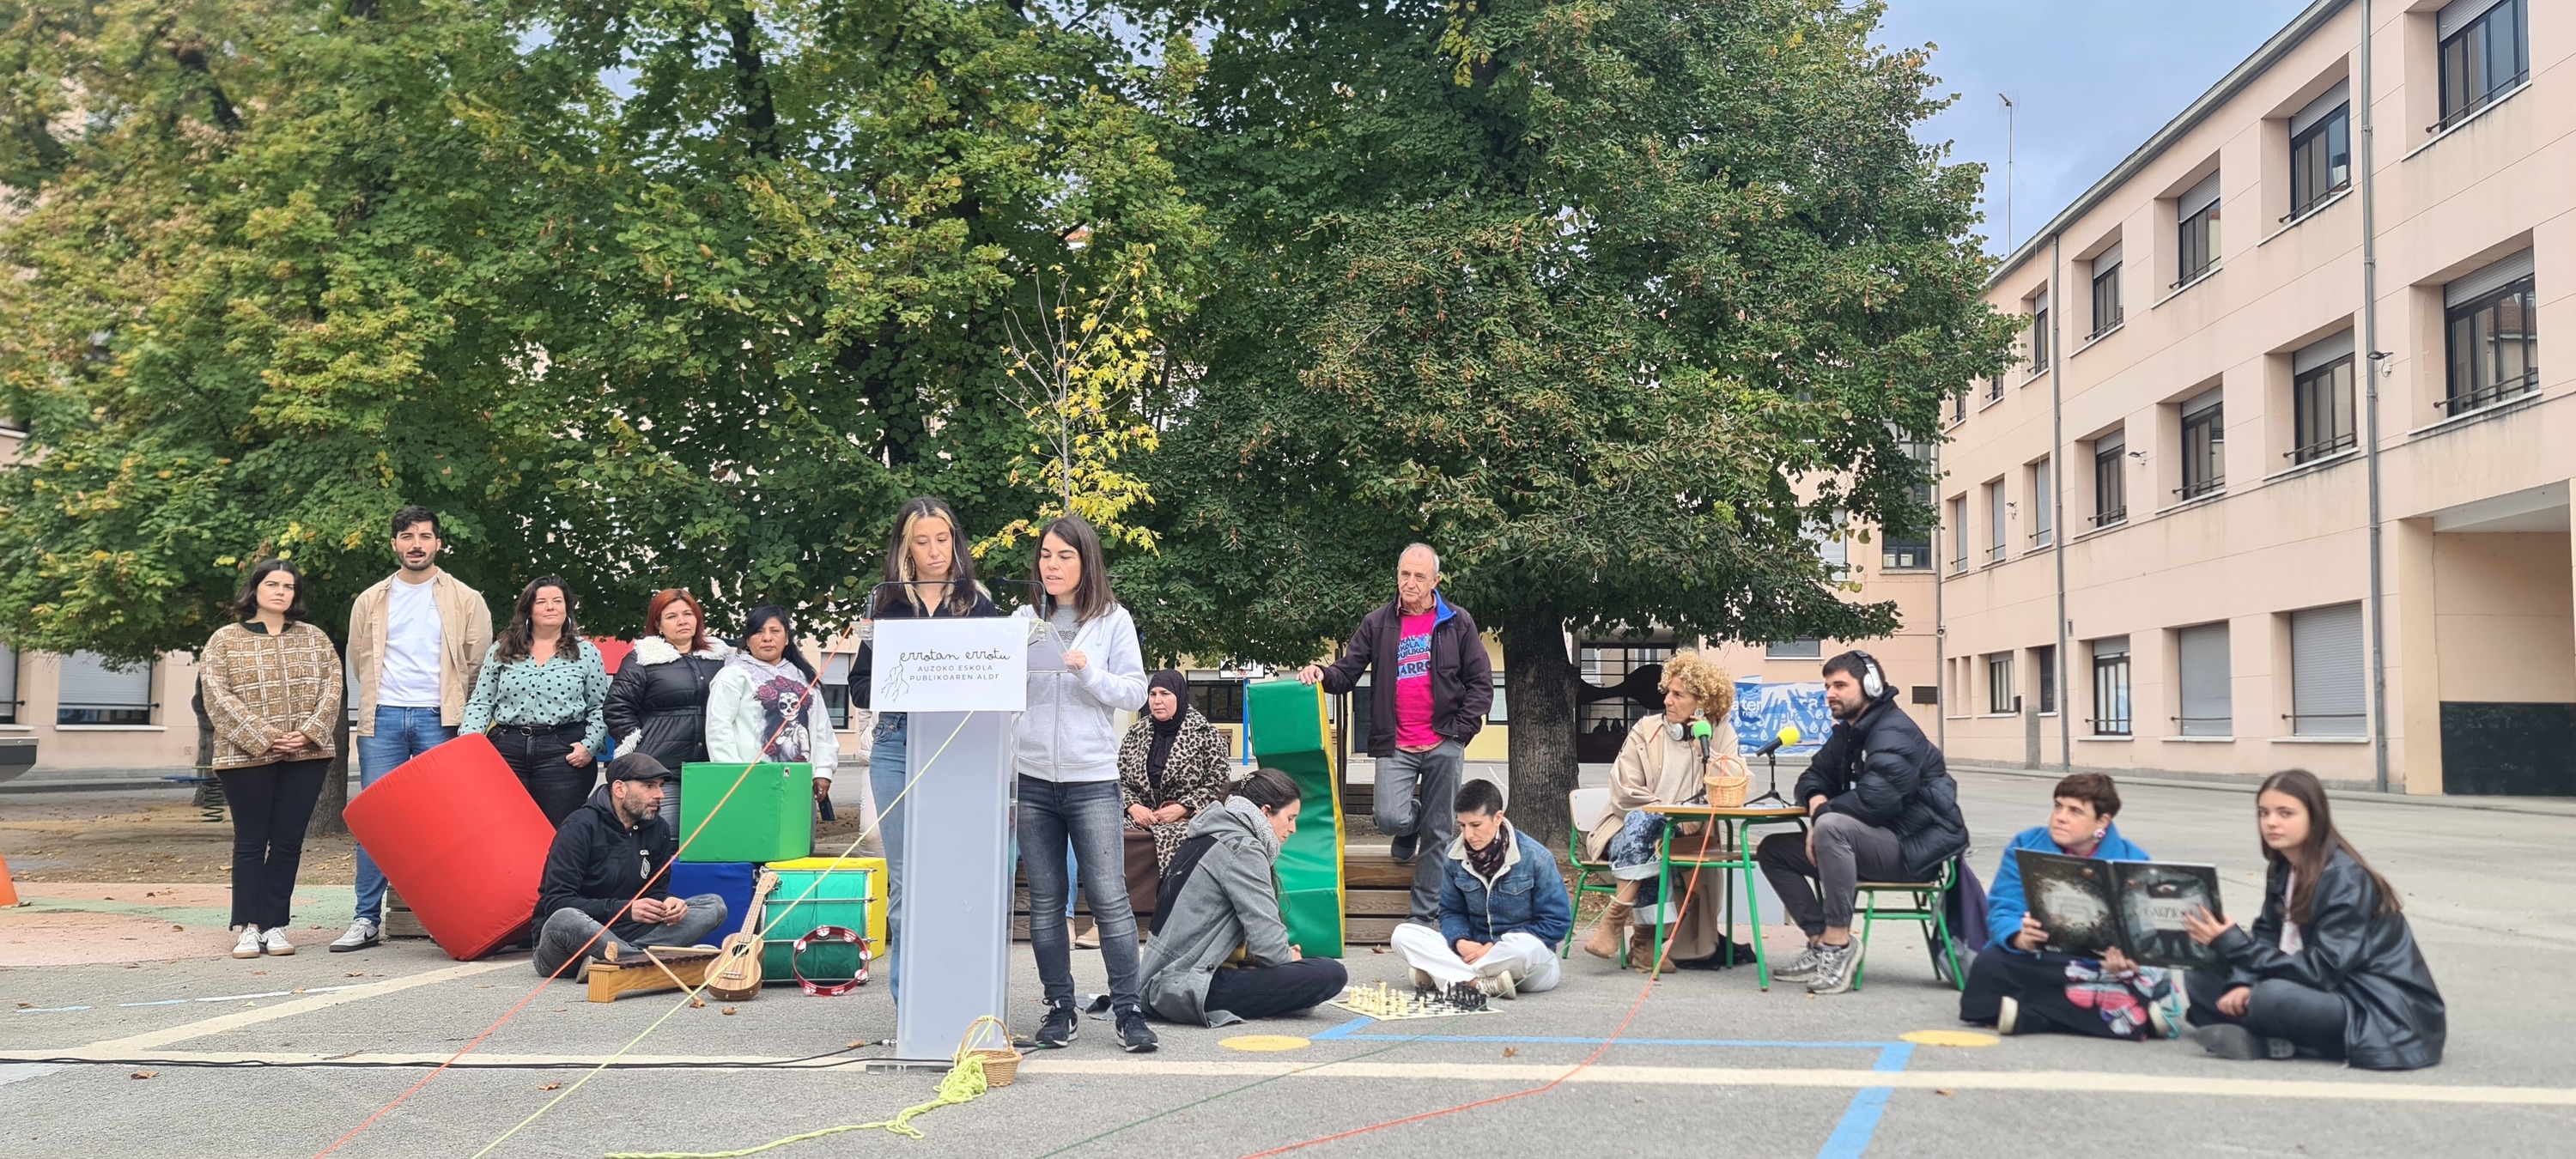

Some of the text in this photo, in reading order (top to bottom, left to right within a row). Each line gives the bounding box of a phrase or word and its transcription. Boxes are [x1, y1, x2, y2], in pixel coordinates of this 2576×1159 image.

[899, 647, 1012, 662] errotan errotu
[1731, 698, 1762, 712] ater
